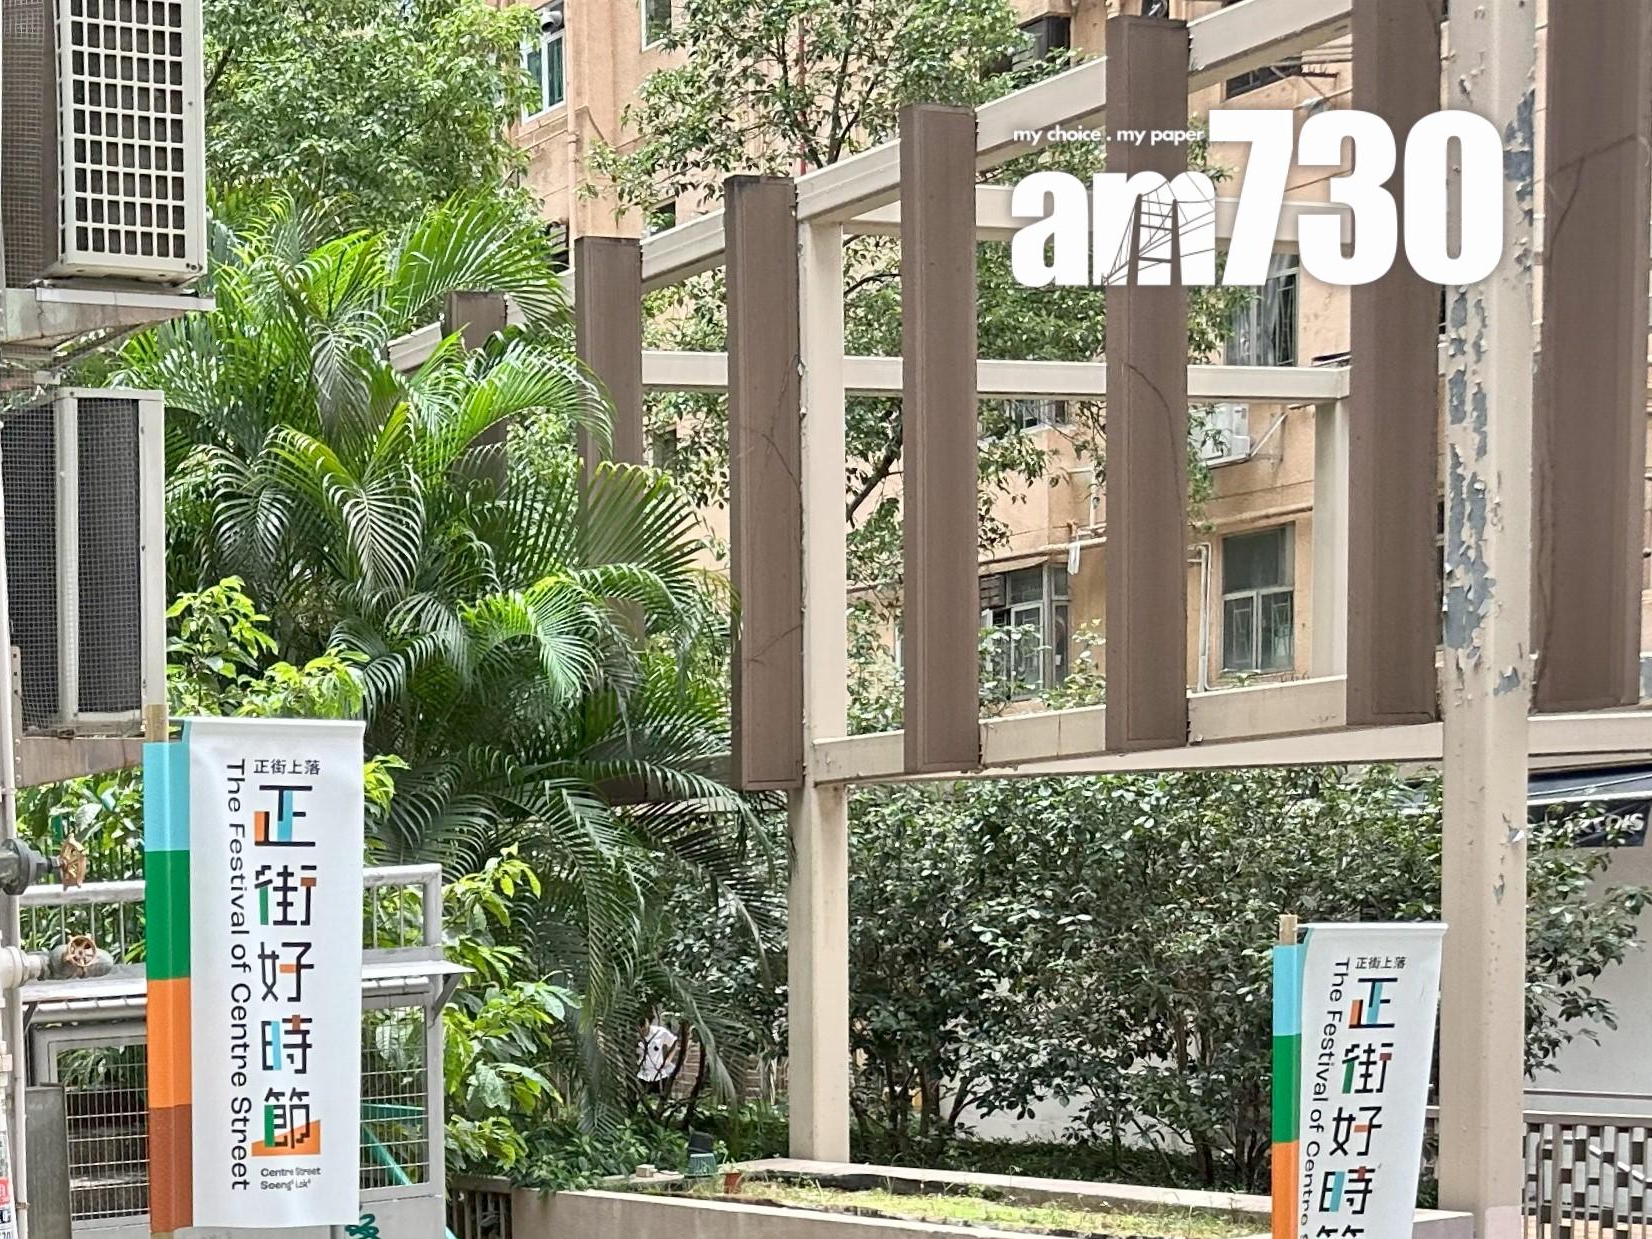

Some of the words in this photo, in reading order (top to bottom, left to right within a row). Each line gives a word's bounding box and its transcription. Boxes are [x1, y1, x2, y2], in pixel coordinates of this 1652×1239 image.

[226, 758, 246, 813] The
[253, 758, 321, 776] 正街上落
[229, 823, 250, 935] Festival
[230, 943, 253, 973] of
[254, 784, 318, 1150] 正街好時節
[1329, 957, 1350, 1002] The
[1354, 956, 1407, 970] 正街上落
[230, 982, 252, 1087] Centre
[1312, 1010, 1343, 1102] Festival
[231, 1096, 252, 1190] Street
[1309, 1108, 1325, 1133] of
[1300, 1140, 1321, 1226] Centre
